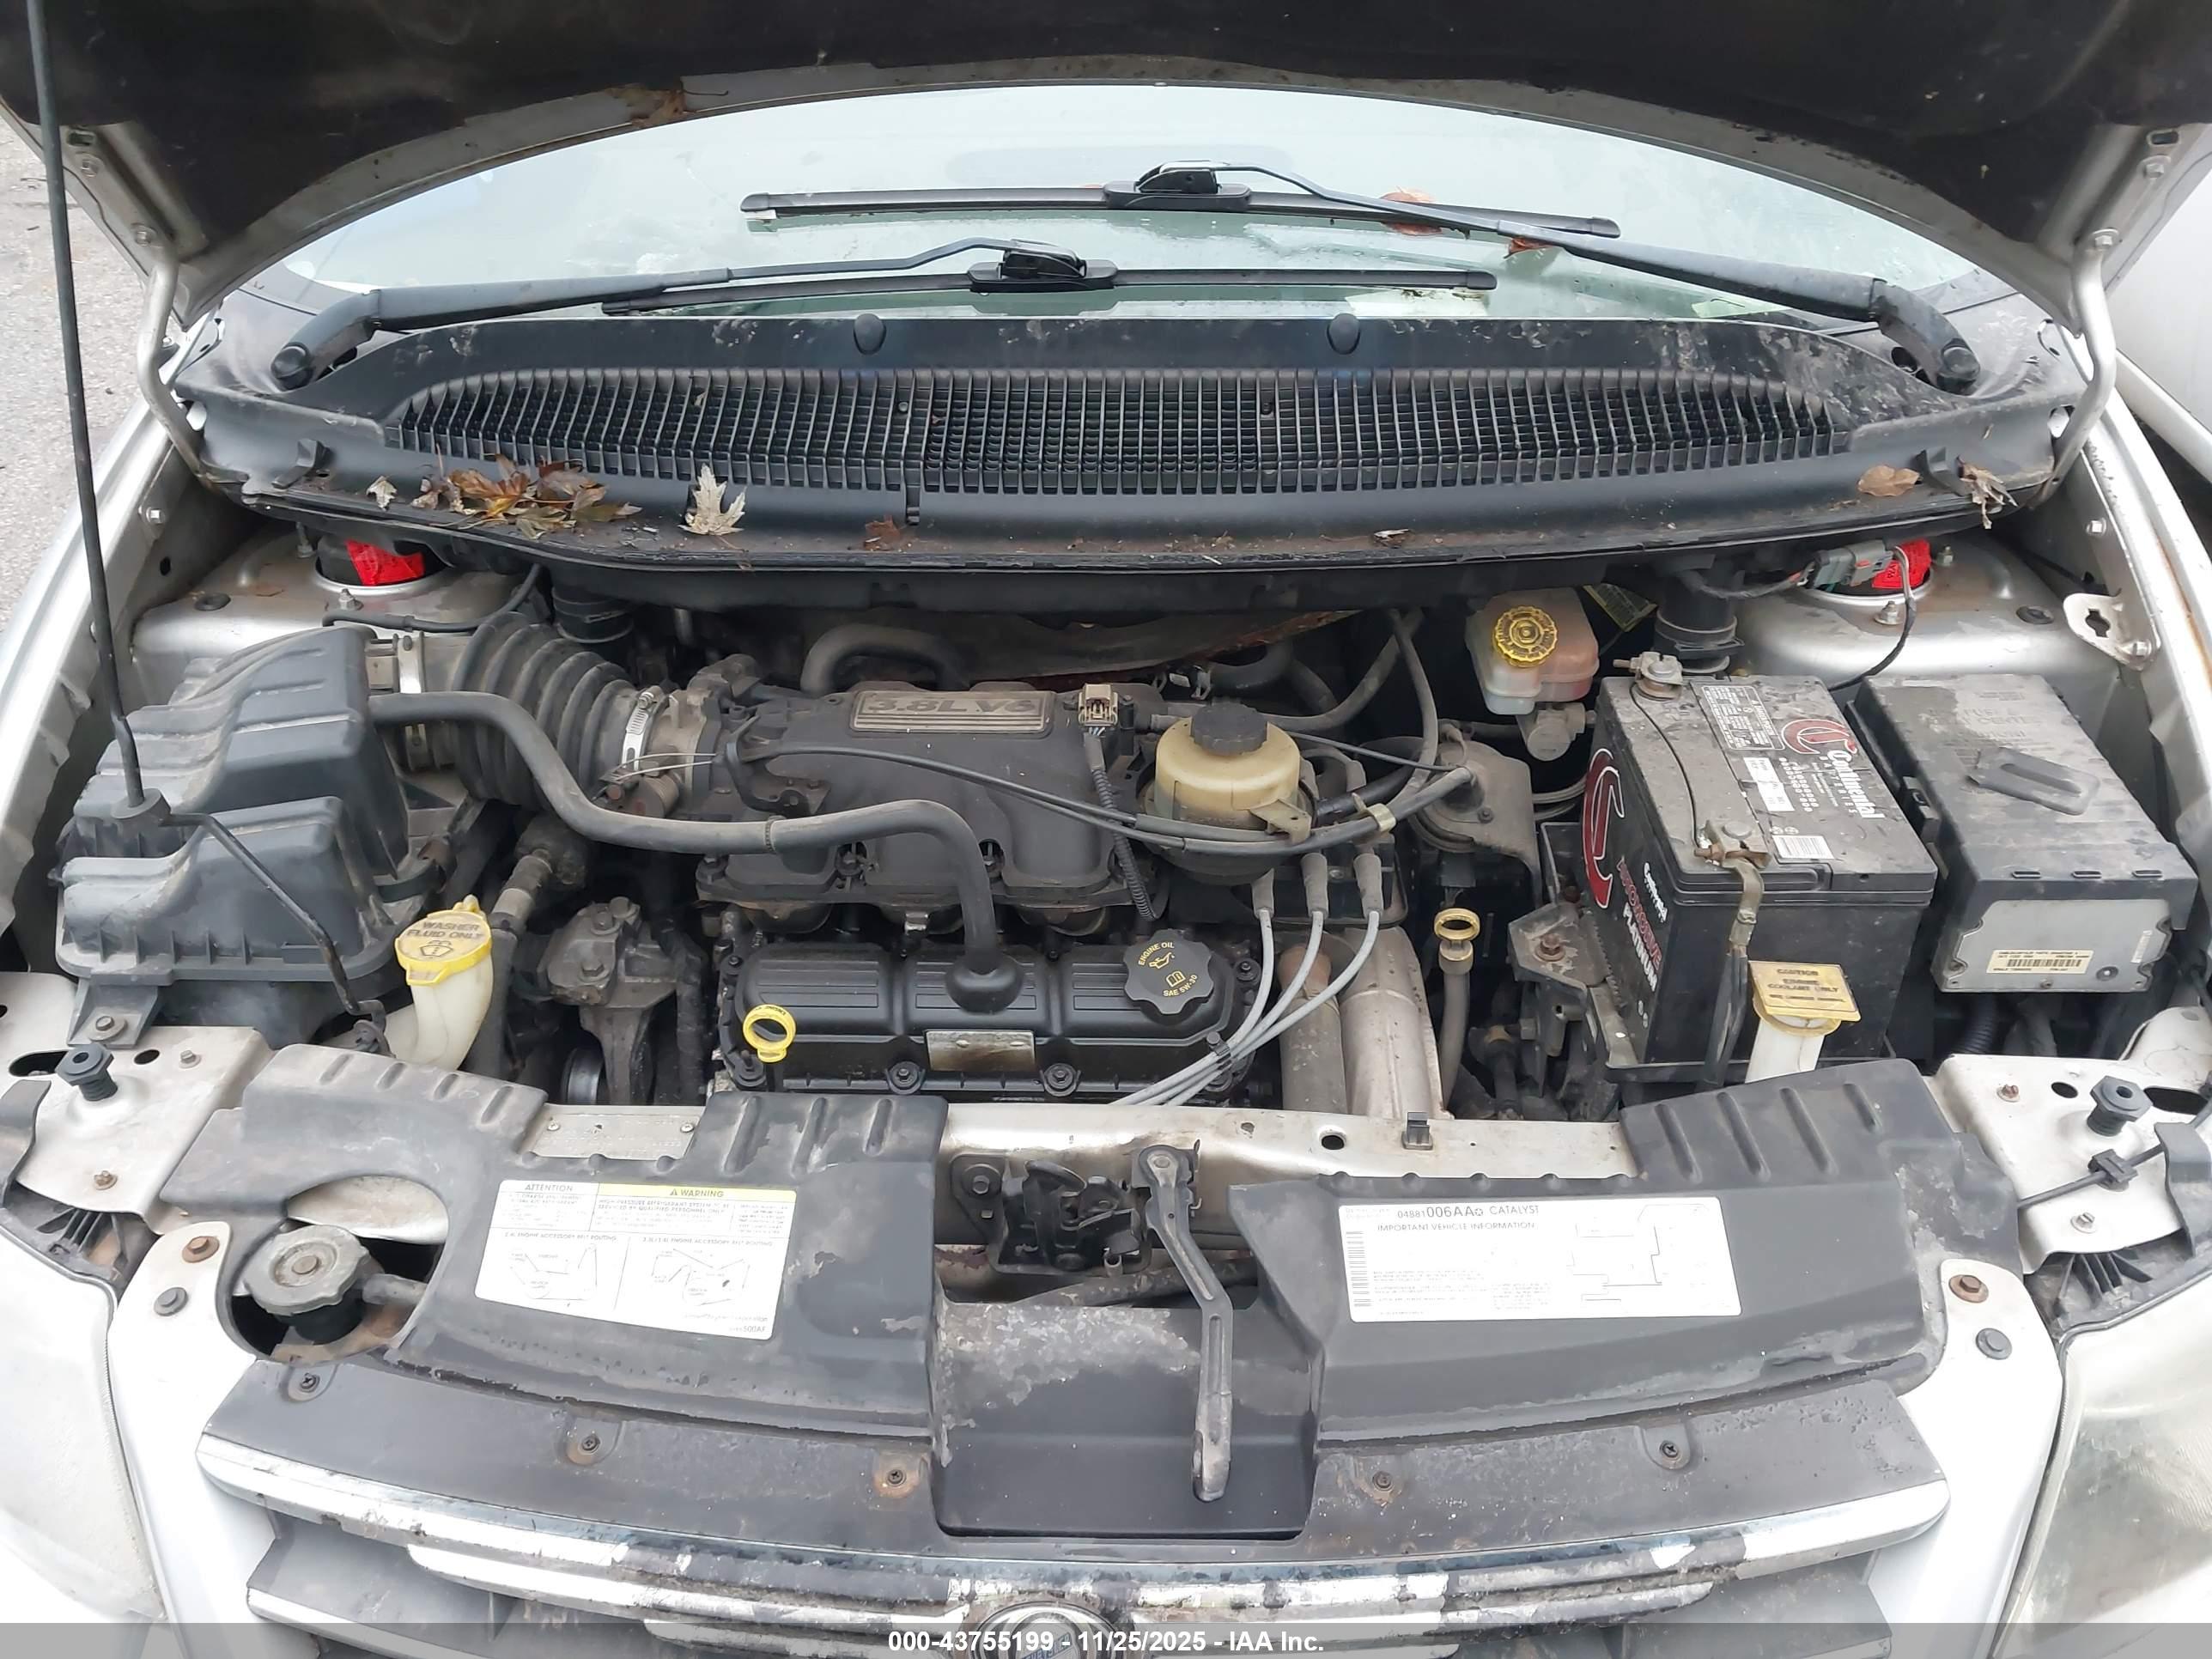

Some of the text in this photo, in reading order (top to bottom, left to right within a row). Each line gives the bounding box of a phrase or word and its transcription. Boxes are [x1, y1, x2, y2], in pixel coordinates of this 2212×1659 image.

[868, 699, 1035, 713] 3.8L V6
[1827, 750, 1886, 818] Continental
[422, 921, 480, 931] WASHER
[448, 931, 484, 939] ONLY
[1623, 902, 1658, 992] PLATINUM
[1138, 943, 1161, 966] ENGINE
[1179, 975, 1198, 994] 5W-30
[525, 1183, 574, 1192] ATTENTION
[680, 1188, 725, 1198] WARNING
[1489, 1206, 1539, 1215] CATALYST
[1377, 1221, 1536, 1232] IMPORTANT VEHICLE INFORMATION
